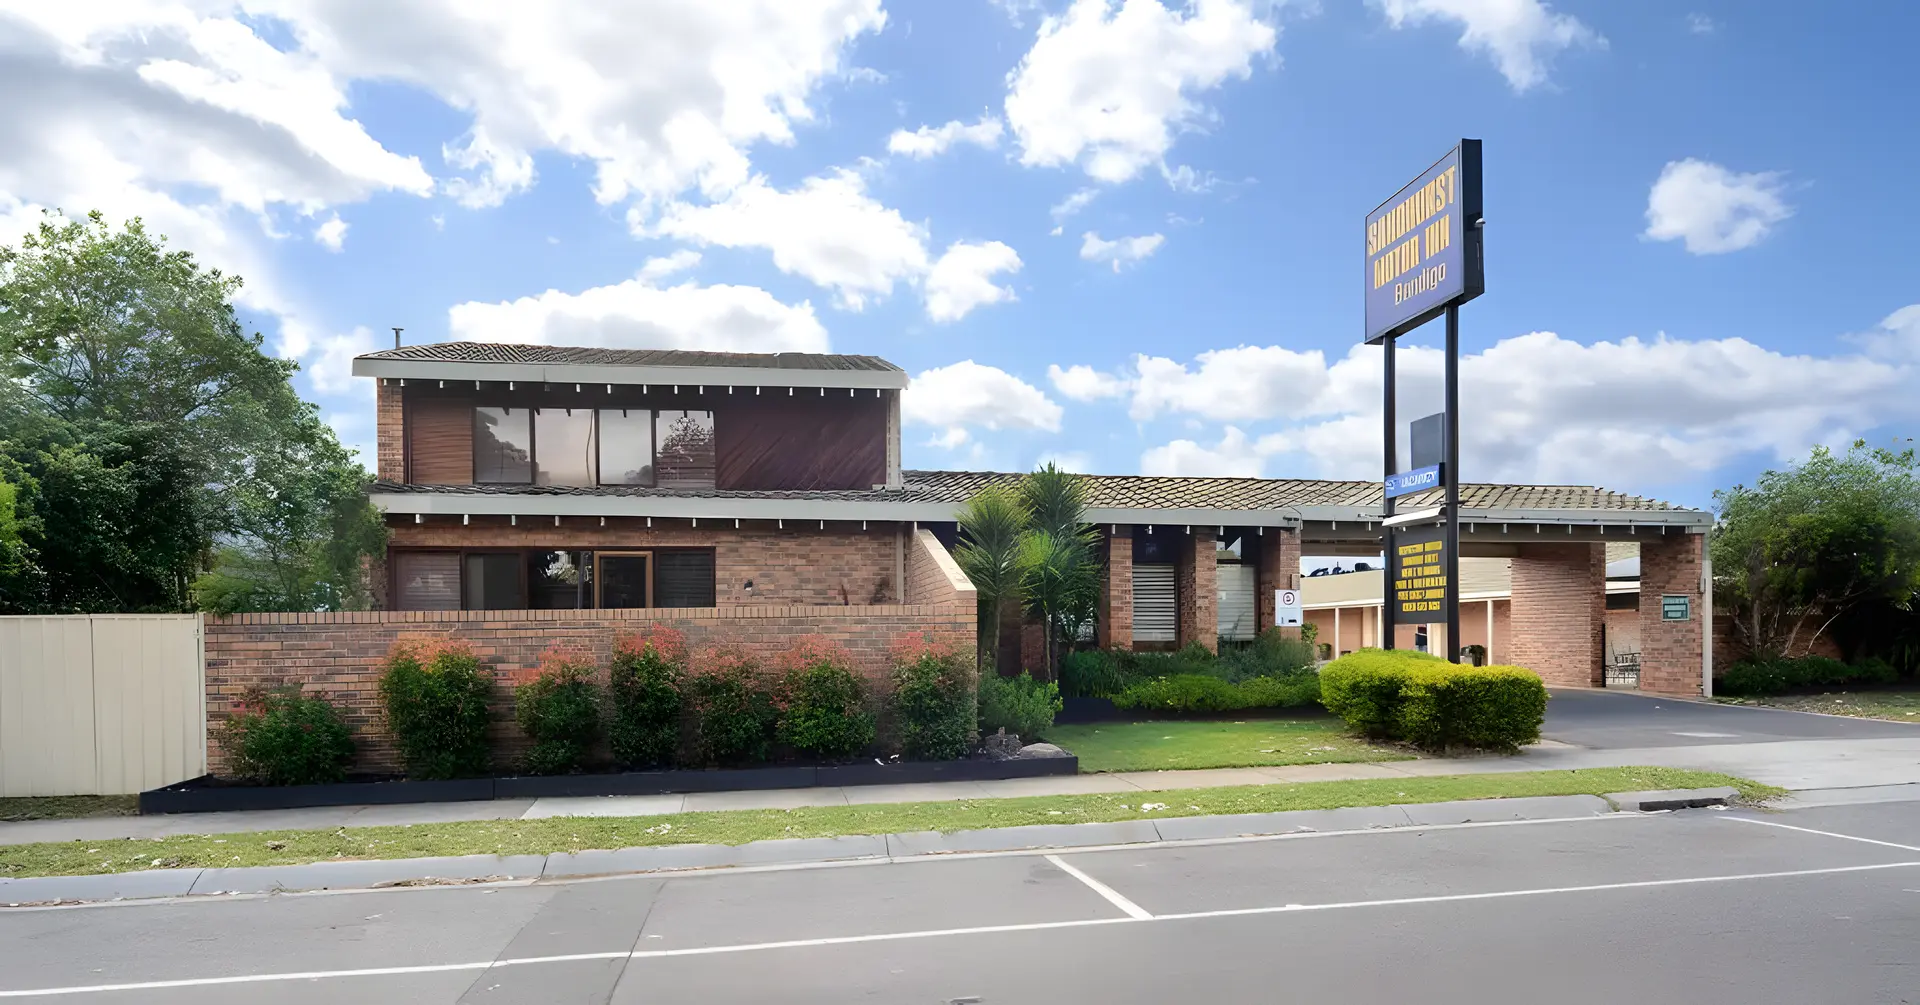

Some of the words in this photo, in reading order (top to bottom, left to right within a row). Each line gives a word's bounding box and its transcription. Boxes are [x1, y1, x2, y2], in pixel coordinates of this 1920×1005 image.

[1368, 165, 1455, 256] SANDHURST
[1374, 234, 1420, 289] MOTOR
[1425, 214, 1450, 260] INN
